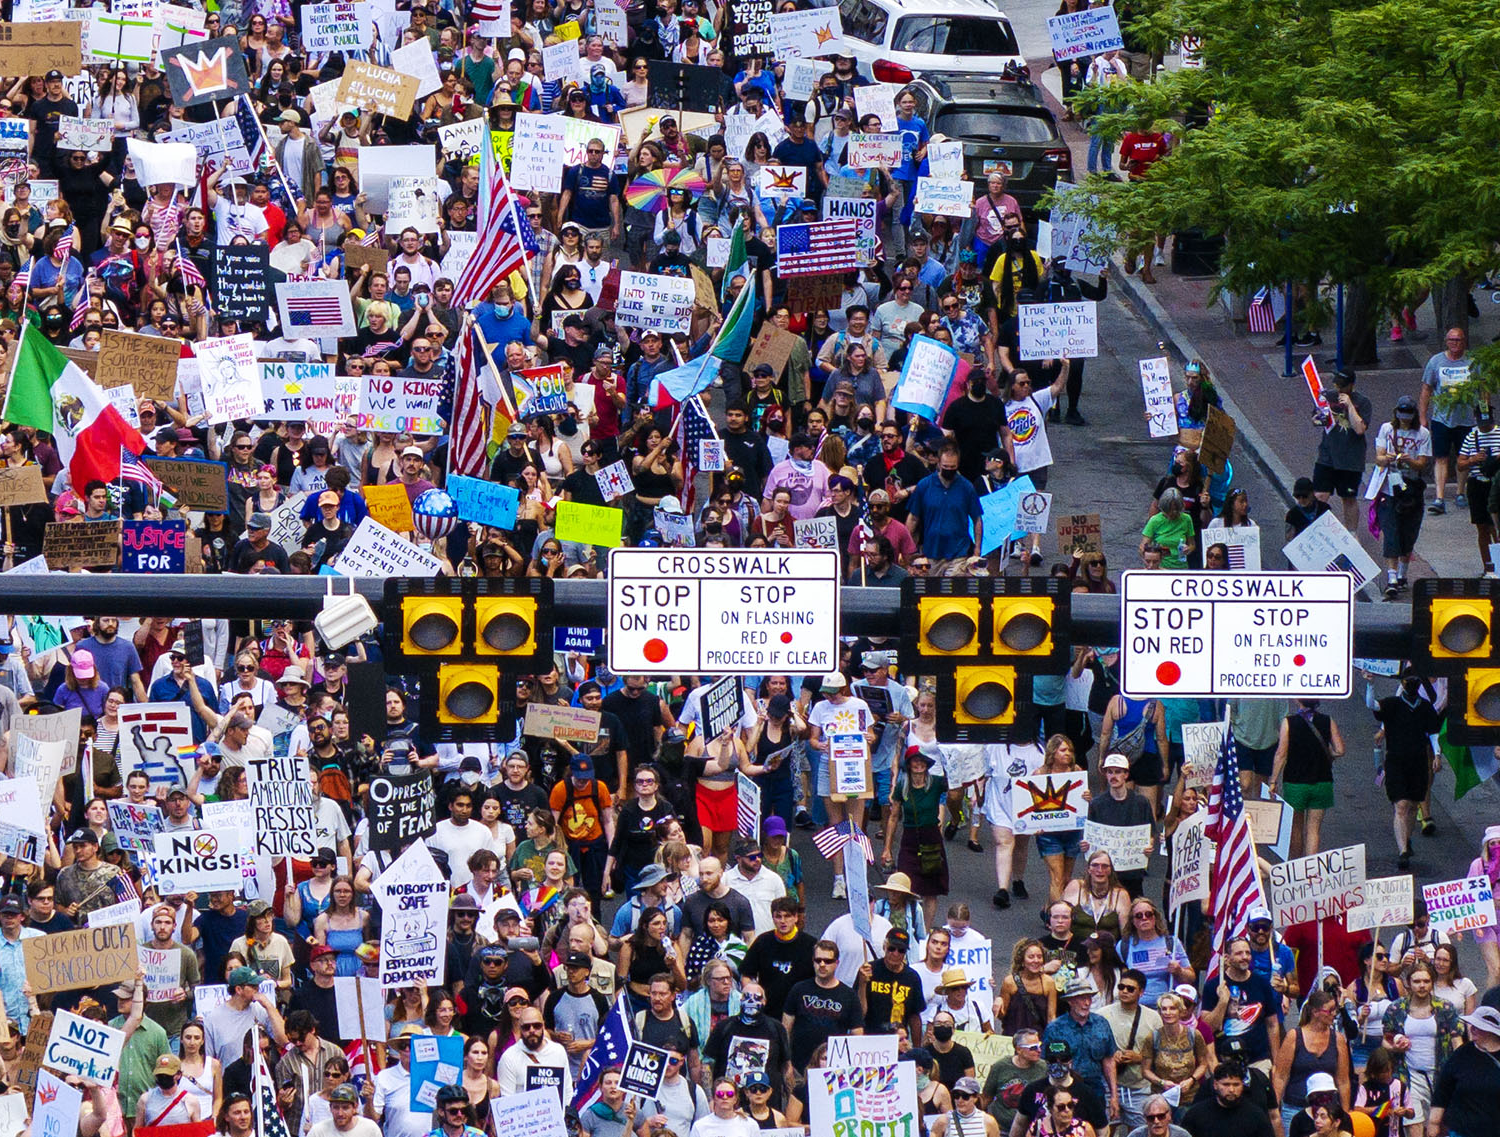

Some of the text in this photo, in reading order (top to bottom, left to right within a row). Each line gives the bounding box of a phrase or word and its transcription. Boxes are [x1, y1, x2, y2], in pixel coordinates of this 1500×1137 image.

[747, 22, 769, 33] DO?
[733, 45, 753, 56] NOT
[1022, 304, 1084, 315] True Power
[1022, 314, 1093, 328] Lies With The
[1042, 327, 1076, 339] People
[1035, 338, 1084, 348] Not One
[1021, 347, 1095, 358] Wannabe Dictator
[368, 379, 442, 397] NO KINGS
[527, 373, 563, 397] YOU
[369, 395, 396, 411] We
[528, 394, 567, 414] BELONG
[357, 413, 443, 433] DRAG QUEENS
[123, 526, 185, 550] JUSTICE
[367, 524, 438, 570] THE MILITARY
[137, 553, 171, 569] FOR
[353, 546, 394, 574] DEFEND
[371, 541, 409, 568] SHOULD
[341, 555, 361, 573] NOT
[658, 556, 791, 574] CROSSWALK
[621, 585, 690, 607] STOP
[740, 586, 796, 603] STOP
[1171, 579, 1304, 597] CROSSWALK
[620, 614, 690, 631] ON RED
[721, 611, 814, 624] ON FLASHING
[1134, 608, 1204, 629] STOP
[1253, 608, 1309, 626] STOP
[741, 631, 767, 644] RED
[1133, 636, 1203, 654] ON RED
[1234, 634, 1328, 647] ON FLASHING
[707, 651, 827, 664] PROCEED IF CLEAR
[1254, 654, 1280, 667] RED
[1220, 674, 1340, 687] PROCEED IF CLEAR
[248, 758, 305, 782] TRUE
[250, 780, 315, 806] AMERICANS
[255, 807, 314, 831] RESIST
[255, 831, 316, 855] KINGS
[159, 853, 239, 876] KINGS!
[1271, 848, 1356, 887] SILENCE
[386, 882, 447, 896] NOBODY IS
[1273, 868, 1360, 906] COMPLIANCE
[1424, 878, 1486, 899] NOBODY IS
[399, 895, 430, 910] SAFE
[1280, 886, 1365, 925] NO KINGS
[1426, 890, 1493, 912] ILLEGAL ON
[1430, 905, 1476, 923] STOLEN
[1454, 915, 1488, 931] LAND
[385, 957, 436, 969] ESPECIALLY
[382, 967, 439, 984] DEMOCRACY
[802, 995, 842, 1012] Vote
[68, 1021, 109, 1049] NOT
[47, 1042, 115, 1080] Complicit
[633, 1051, 658, 1071] NO
[626, 1067, 658, 1086] KINGS
